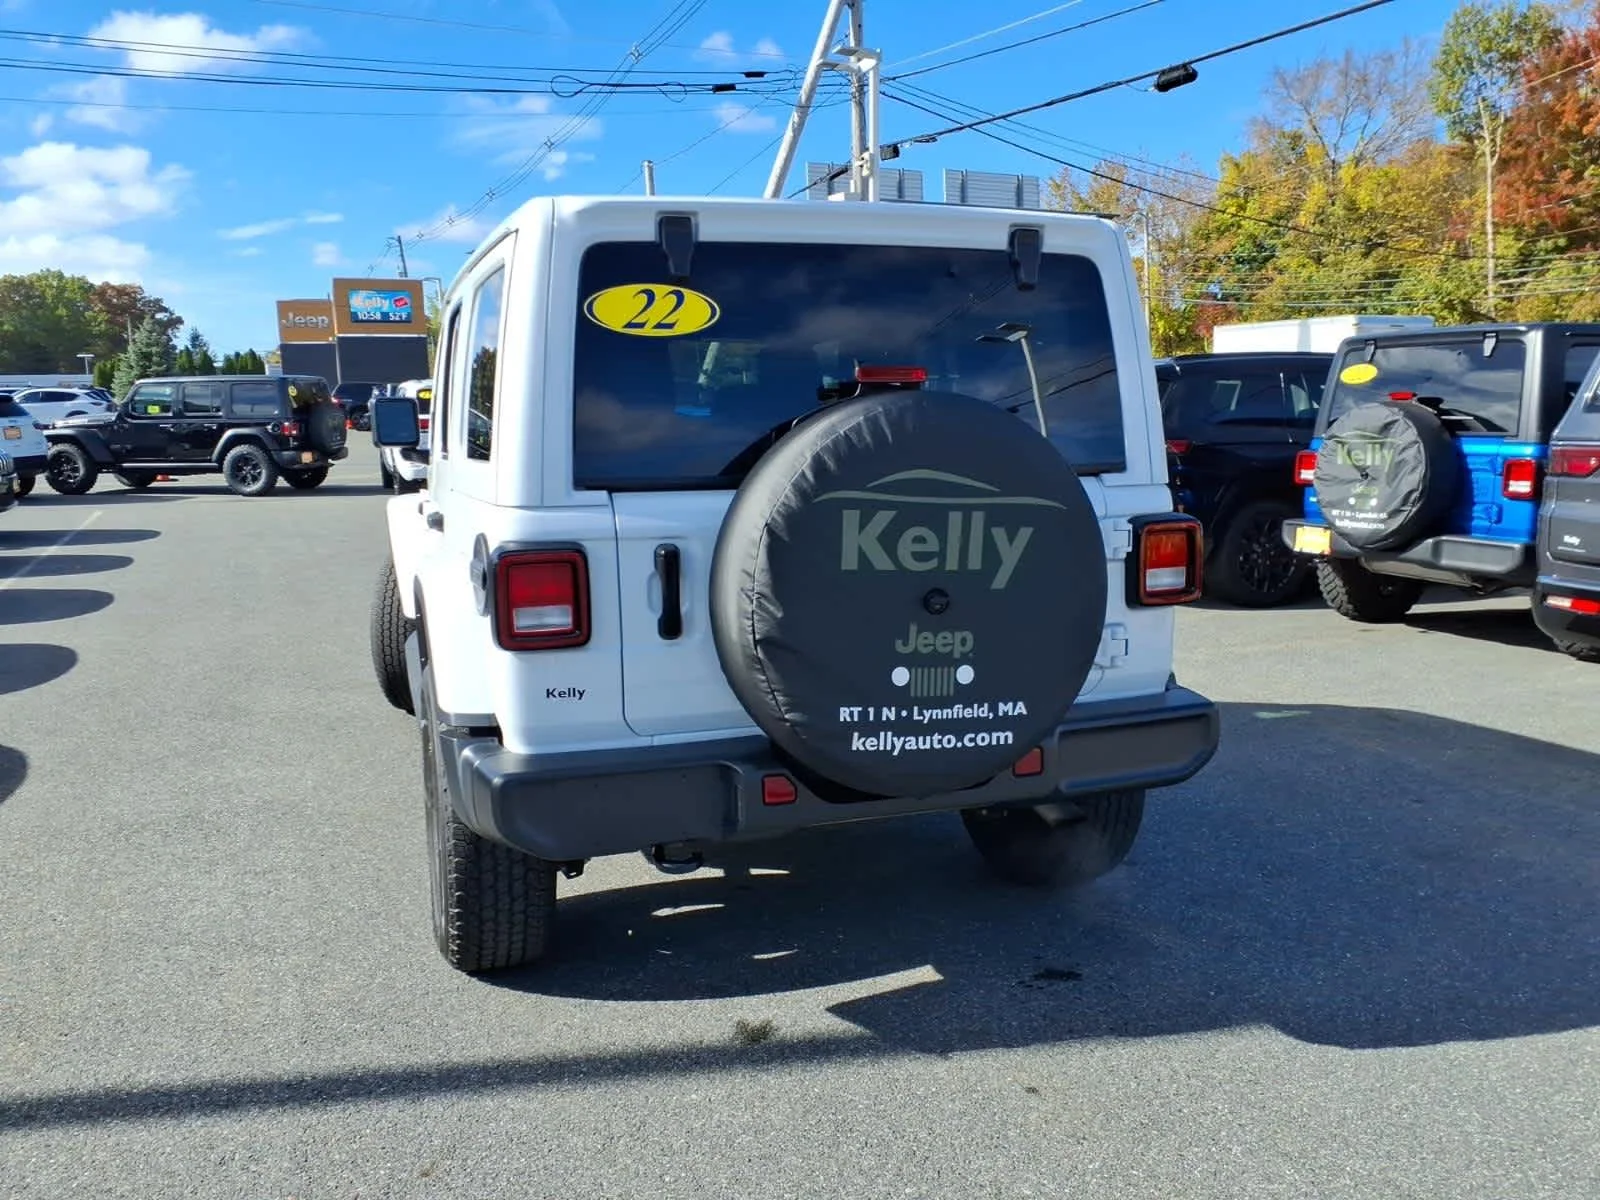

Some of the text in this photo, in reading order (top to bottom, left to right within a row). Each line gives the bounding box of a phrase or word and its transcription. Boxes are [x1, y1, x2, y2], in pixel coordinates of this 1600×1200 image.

[280, 312, 329, 329] Jeep
[622, 288, 685, 330] 22
[840, 509, 1034, 590] Kelly
[894, 621, 974, 659] Jeep
[546, 687, 586, 701] Kelly
[839, 701, 1028, 724] RT 1 N Lynnfield, MA
[851, 731, 1013, 756] kellyauto.com
